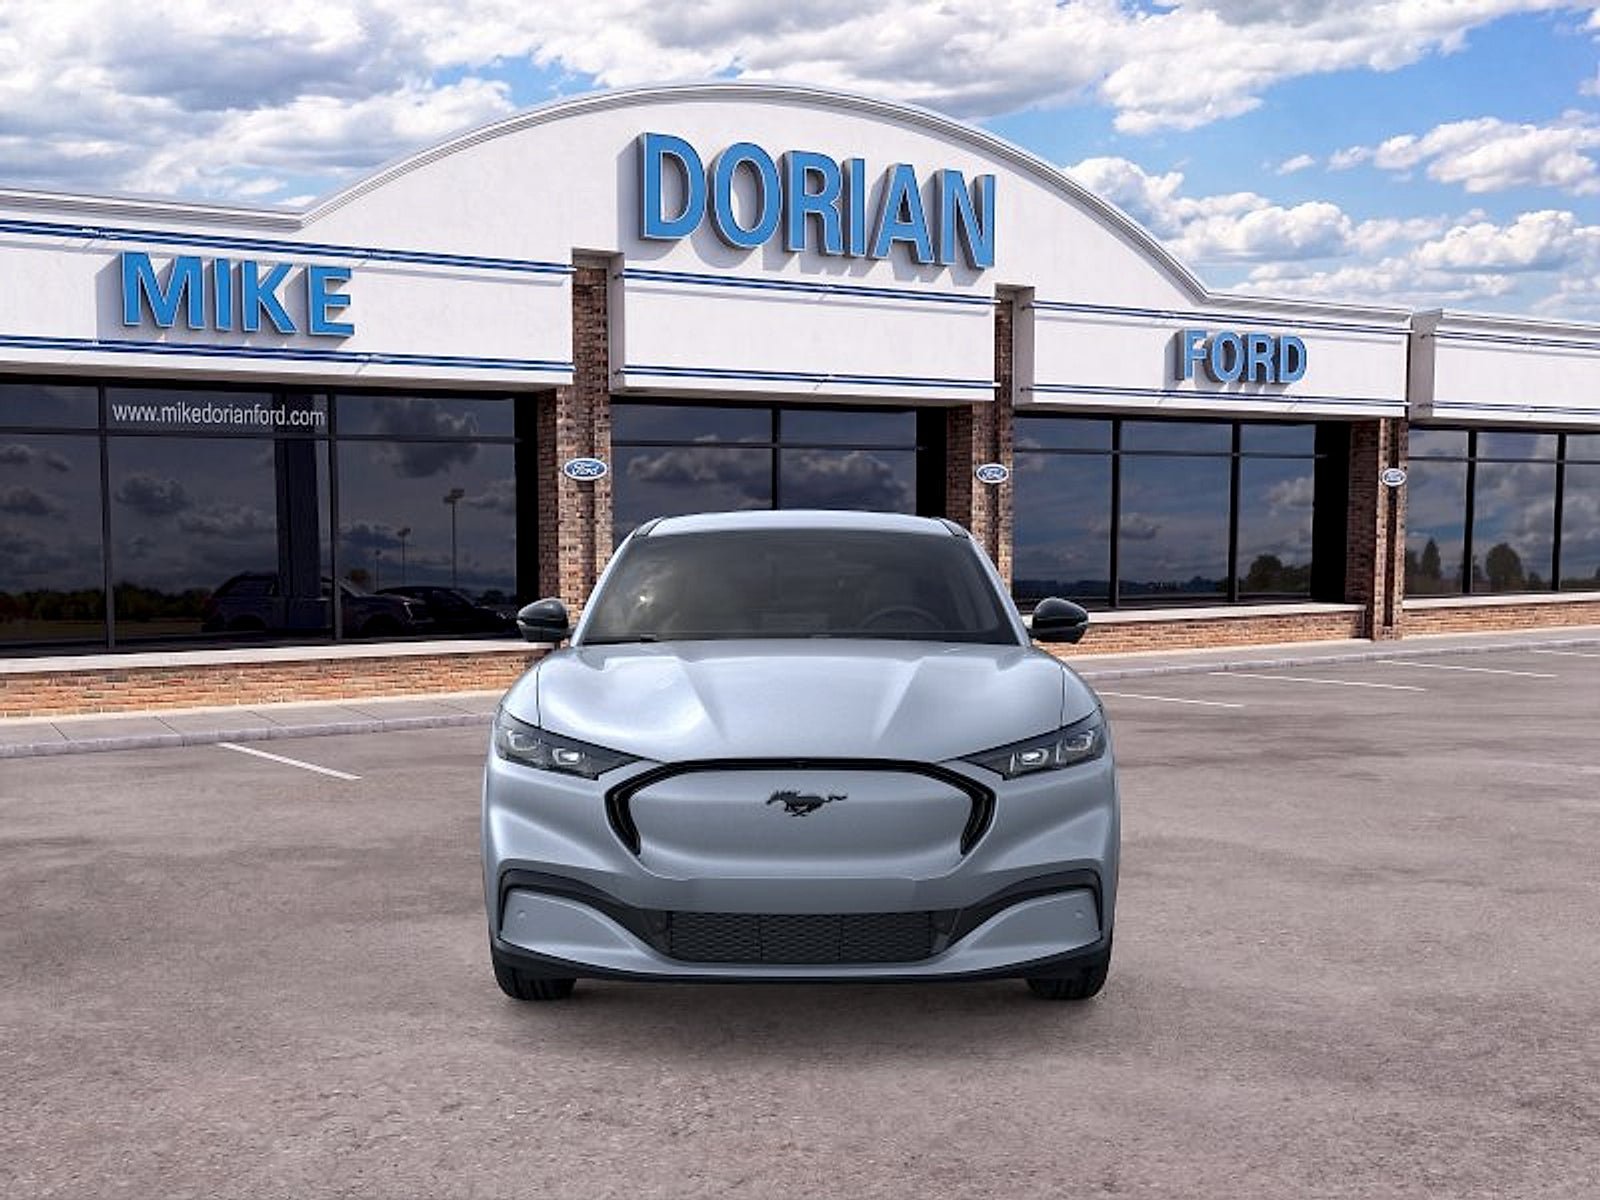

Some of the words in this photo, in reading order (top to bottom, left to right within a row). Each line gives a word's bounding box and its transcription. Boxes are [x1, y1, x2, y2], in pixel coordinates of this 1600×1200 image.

[639, 132, 996, 269] DORIAN
[121, 251, 355, 337] MIKE
[1178, 329, 1307, 384] FORD
[112, 402, 325, 426] www.mikedorianford.com
